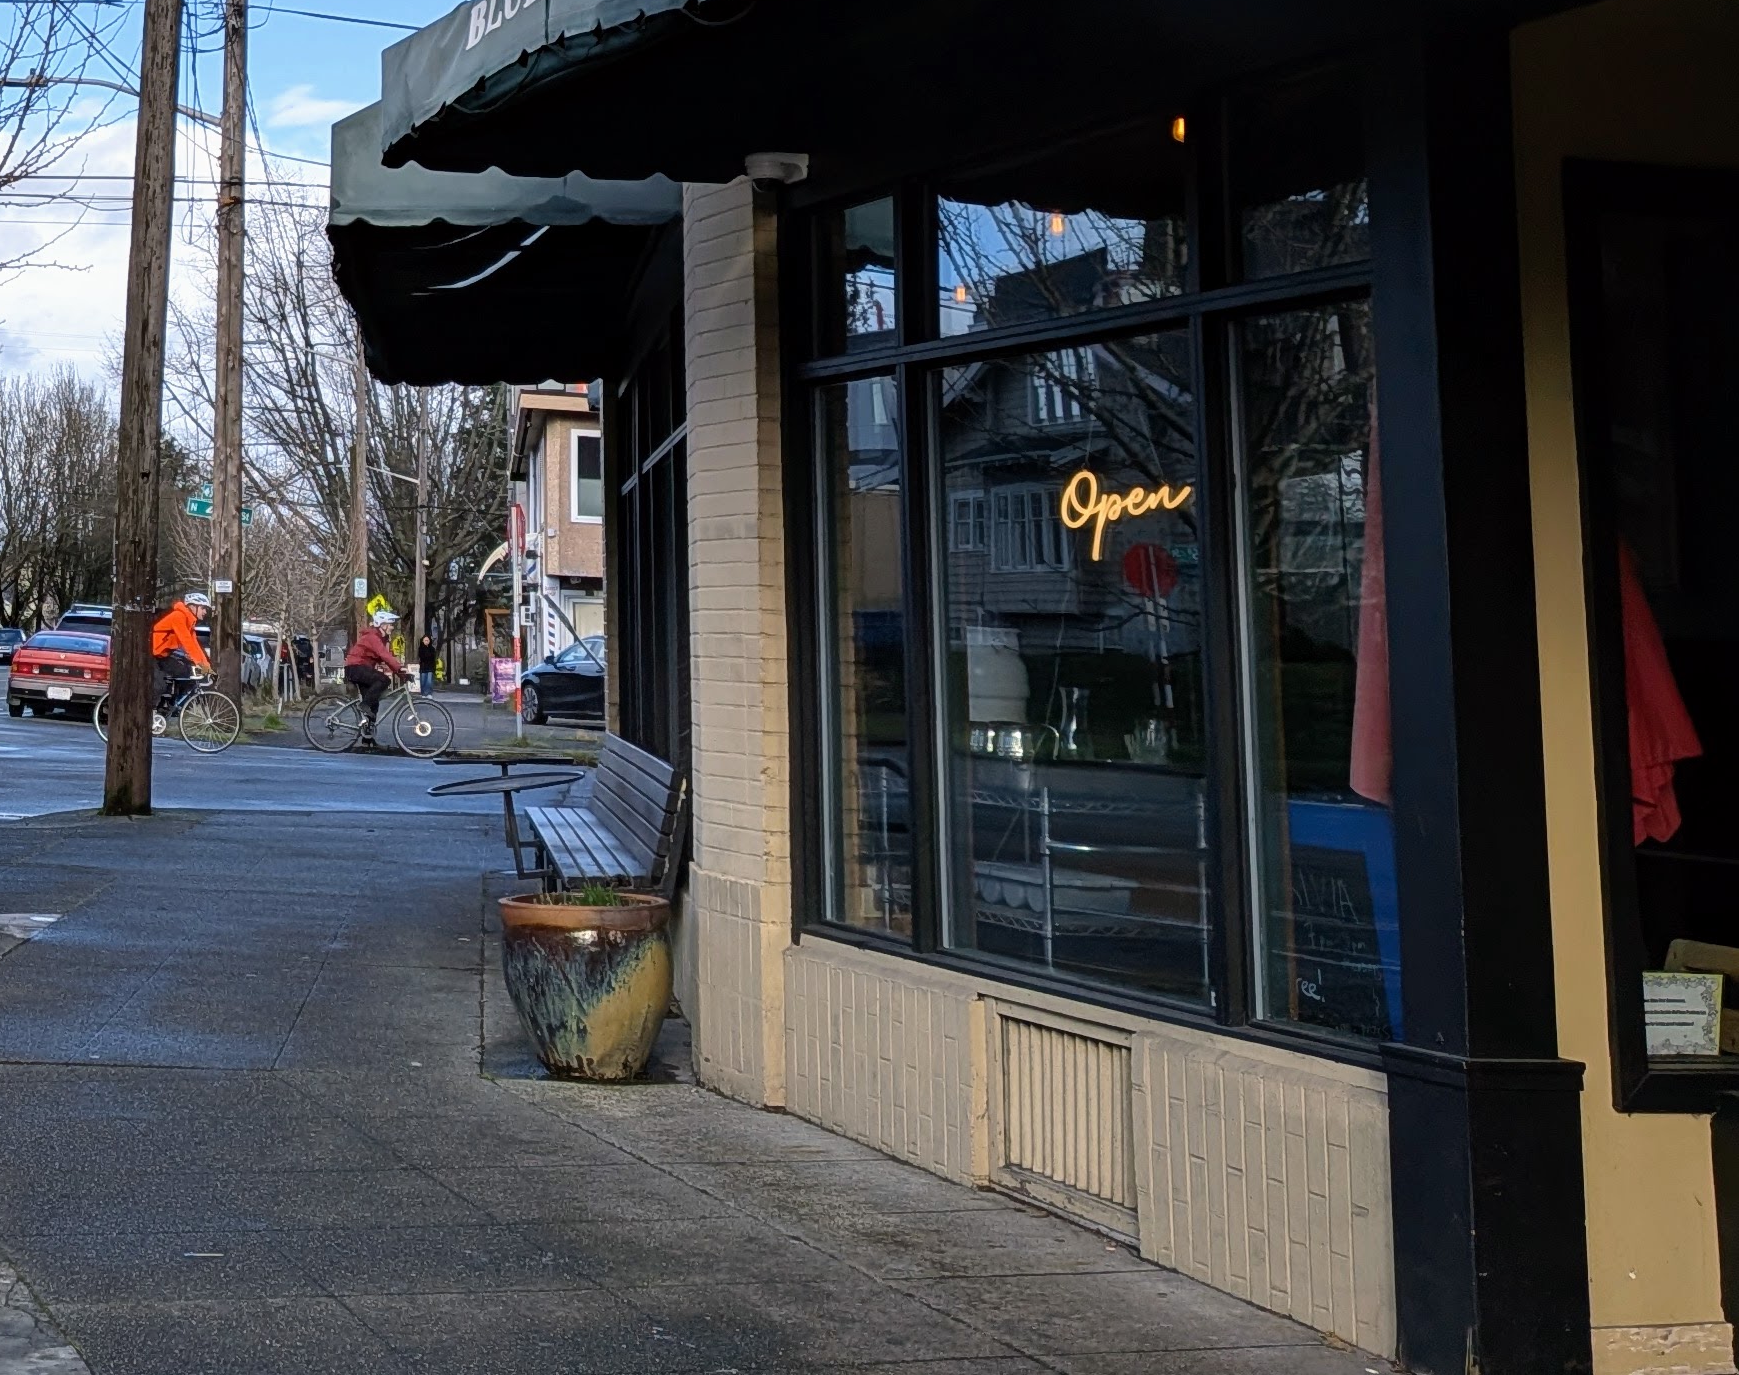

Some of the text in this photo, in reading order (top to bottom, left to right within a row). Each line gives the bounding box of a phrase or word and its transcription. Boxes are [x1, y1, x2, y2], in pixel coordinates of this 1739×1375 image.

[190, 502, 198, 512] N
[241, 511, 250, 521] St
[1060, 469, 1192, 562] Open
